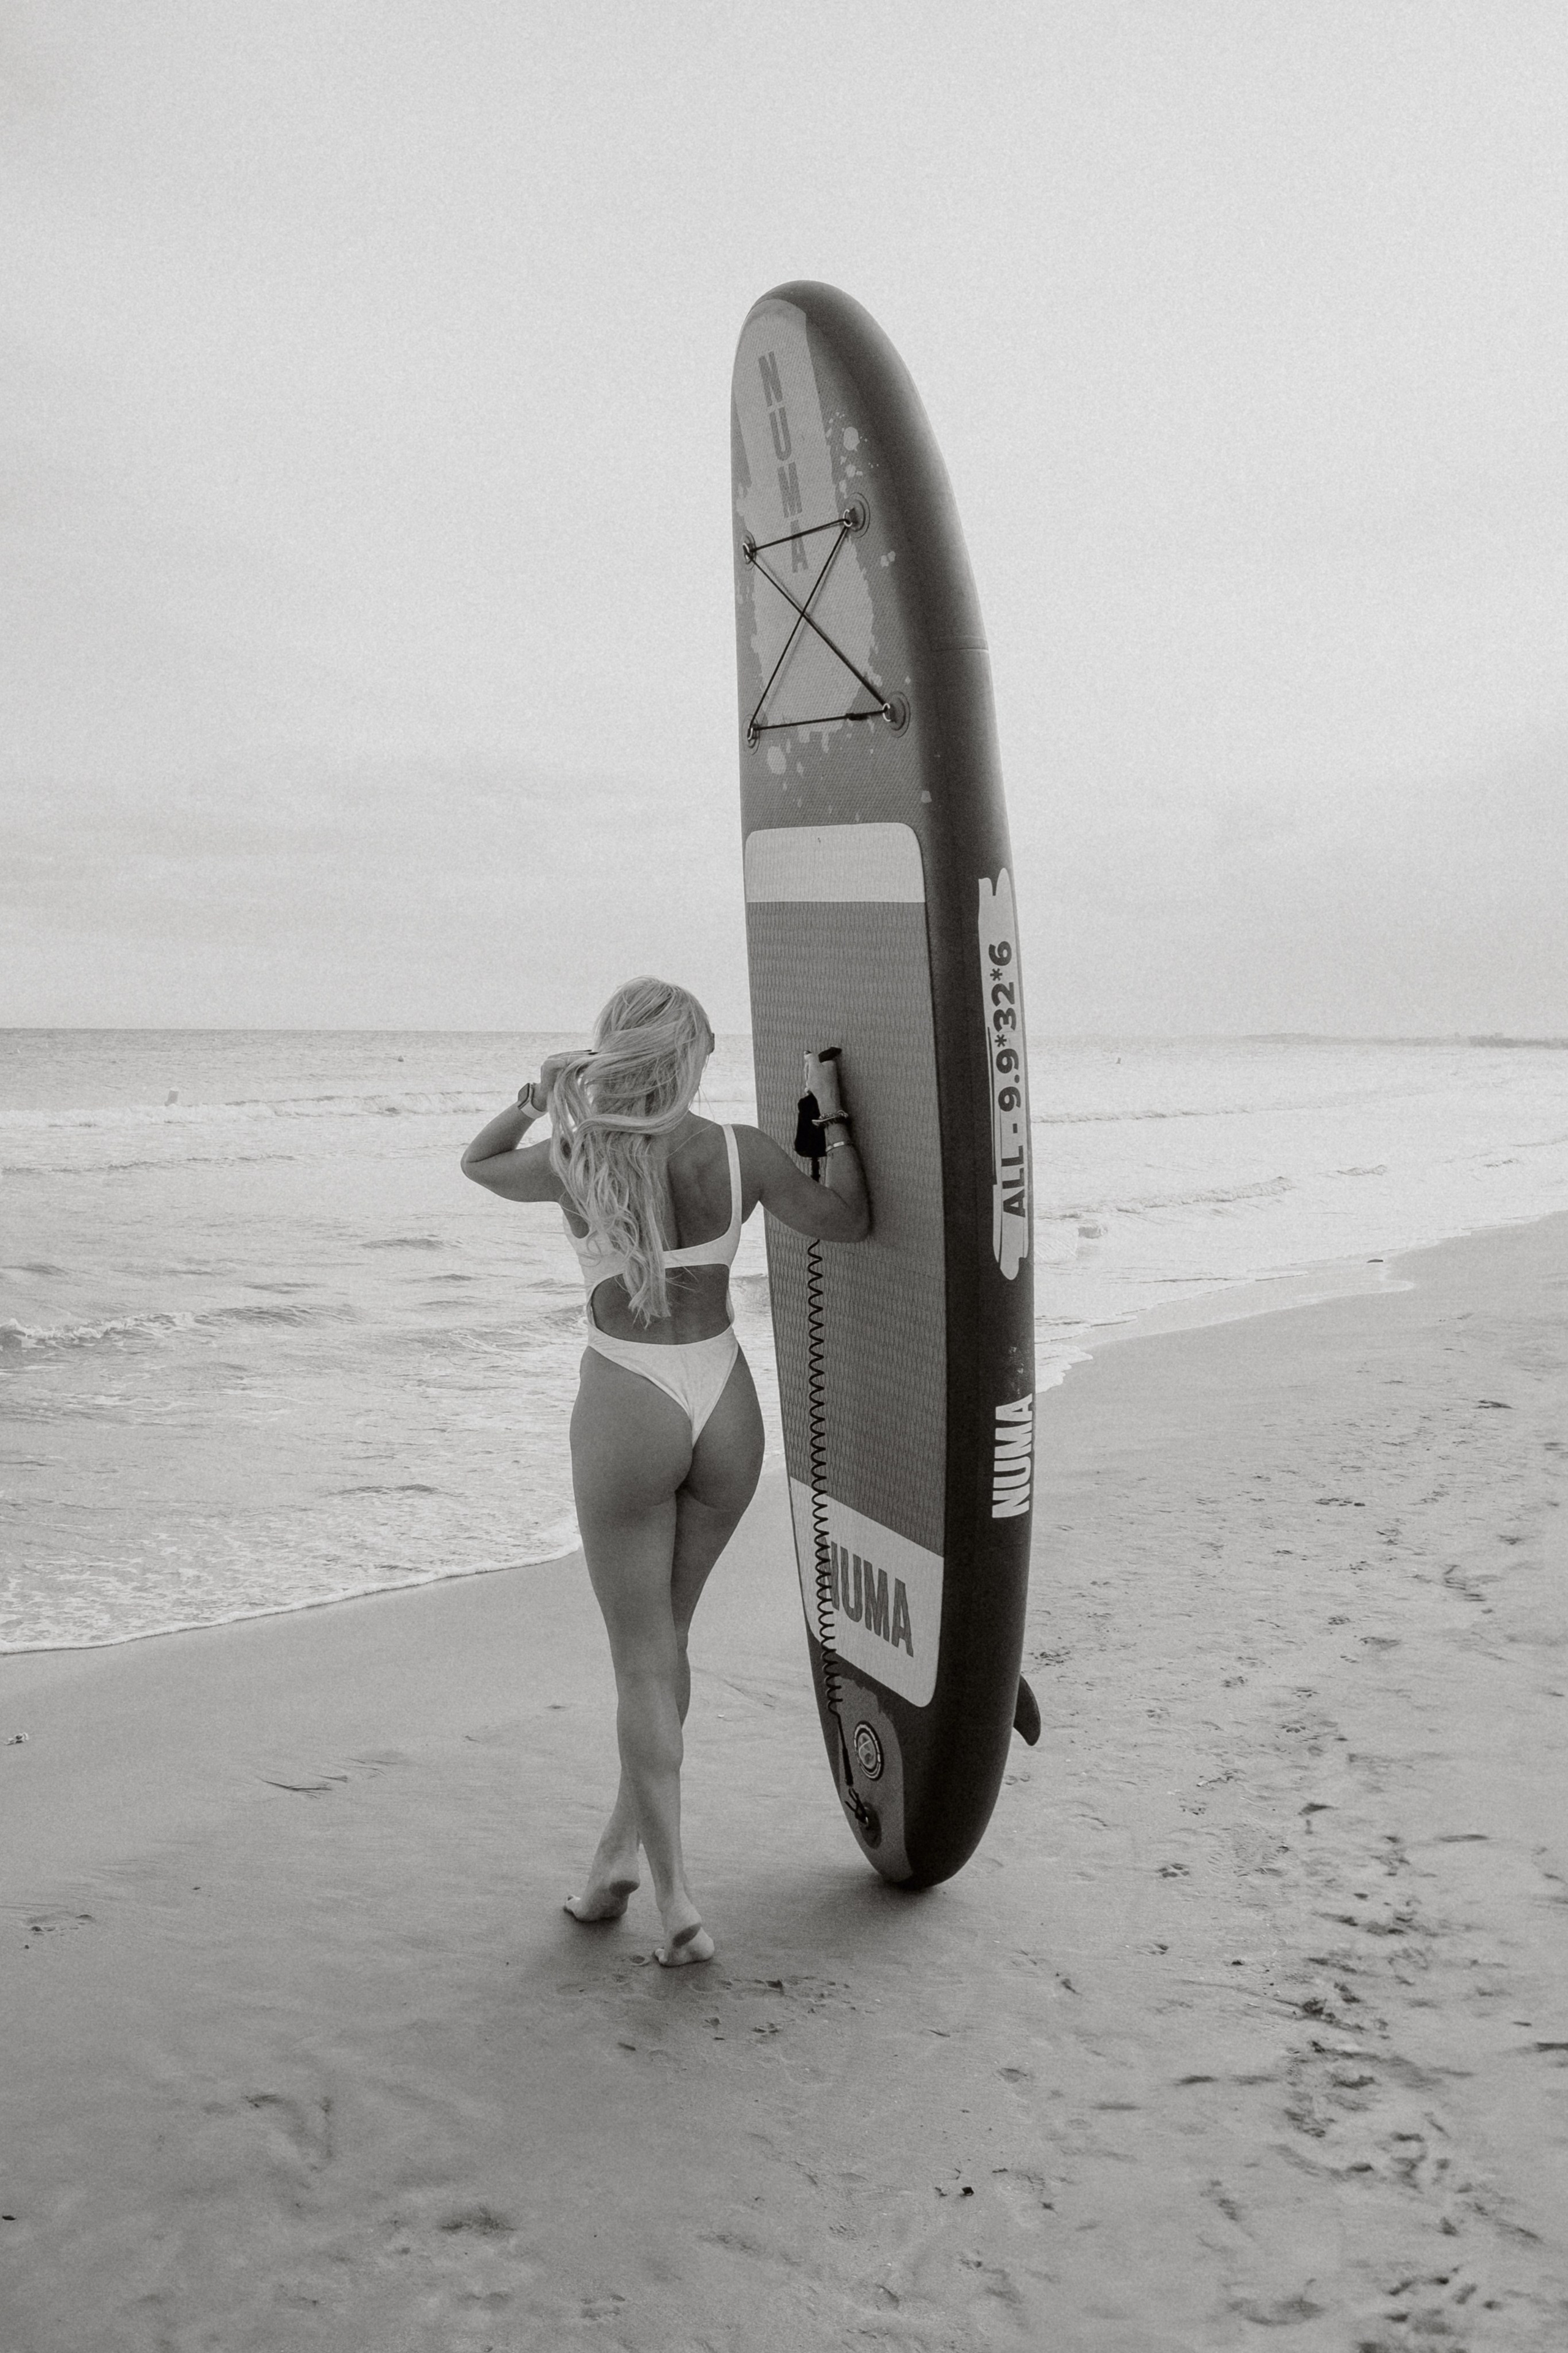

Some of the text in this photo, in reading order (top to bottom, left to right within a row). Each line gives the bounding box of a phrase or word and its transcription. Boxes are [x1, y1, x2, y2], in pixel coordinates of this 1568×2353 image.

[758, 350, 809, 573] NUMA
[1001, 1145, 1026, 1218] ALL
[991, 1392, 1033, 1519] NUMA
